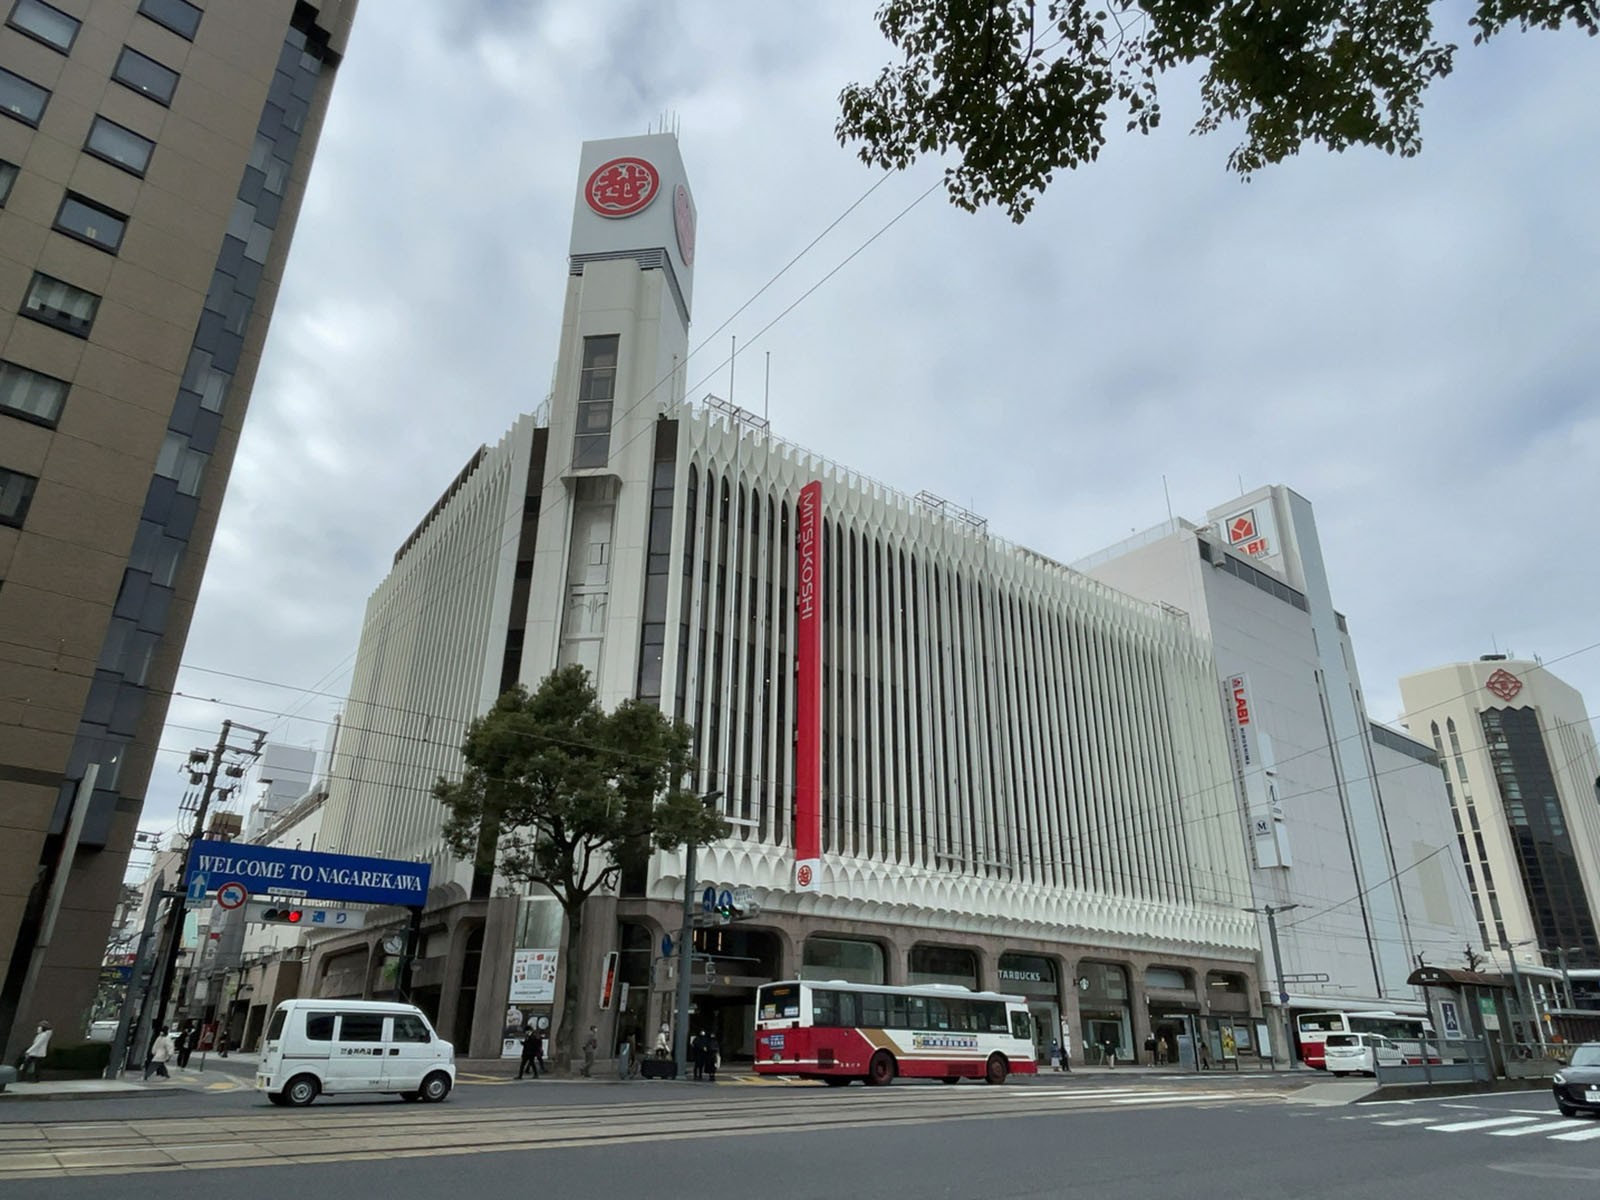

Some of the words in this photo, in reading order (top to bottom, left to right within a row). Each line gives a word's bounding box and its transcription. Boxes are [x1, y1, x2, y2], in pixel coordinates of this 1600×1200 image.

[801, 491, 814, 620] MITSUKOSHI
[1237, 538, 1266, 555] BI
[1233, 688, 1250, 725] LABI
[1240, 727, 1250, 766] HIROSHIMA
[198, 854, 285, 879] WELCOME
[290, 863, 313, 882] TO
[316, 867, 422, 892] NAGAREKAWA
[998, 969, 1041, 982] TARBUCKS
